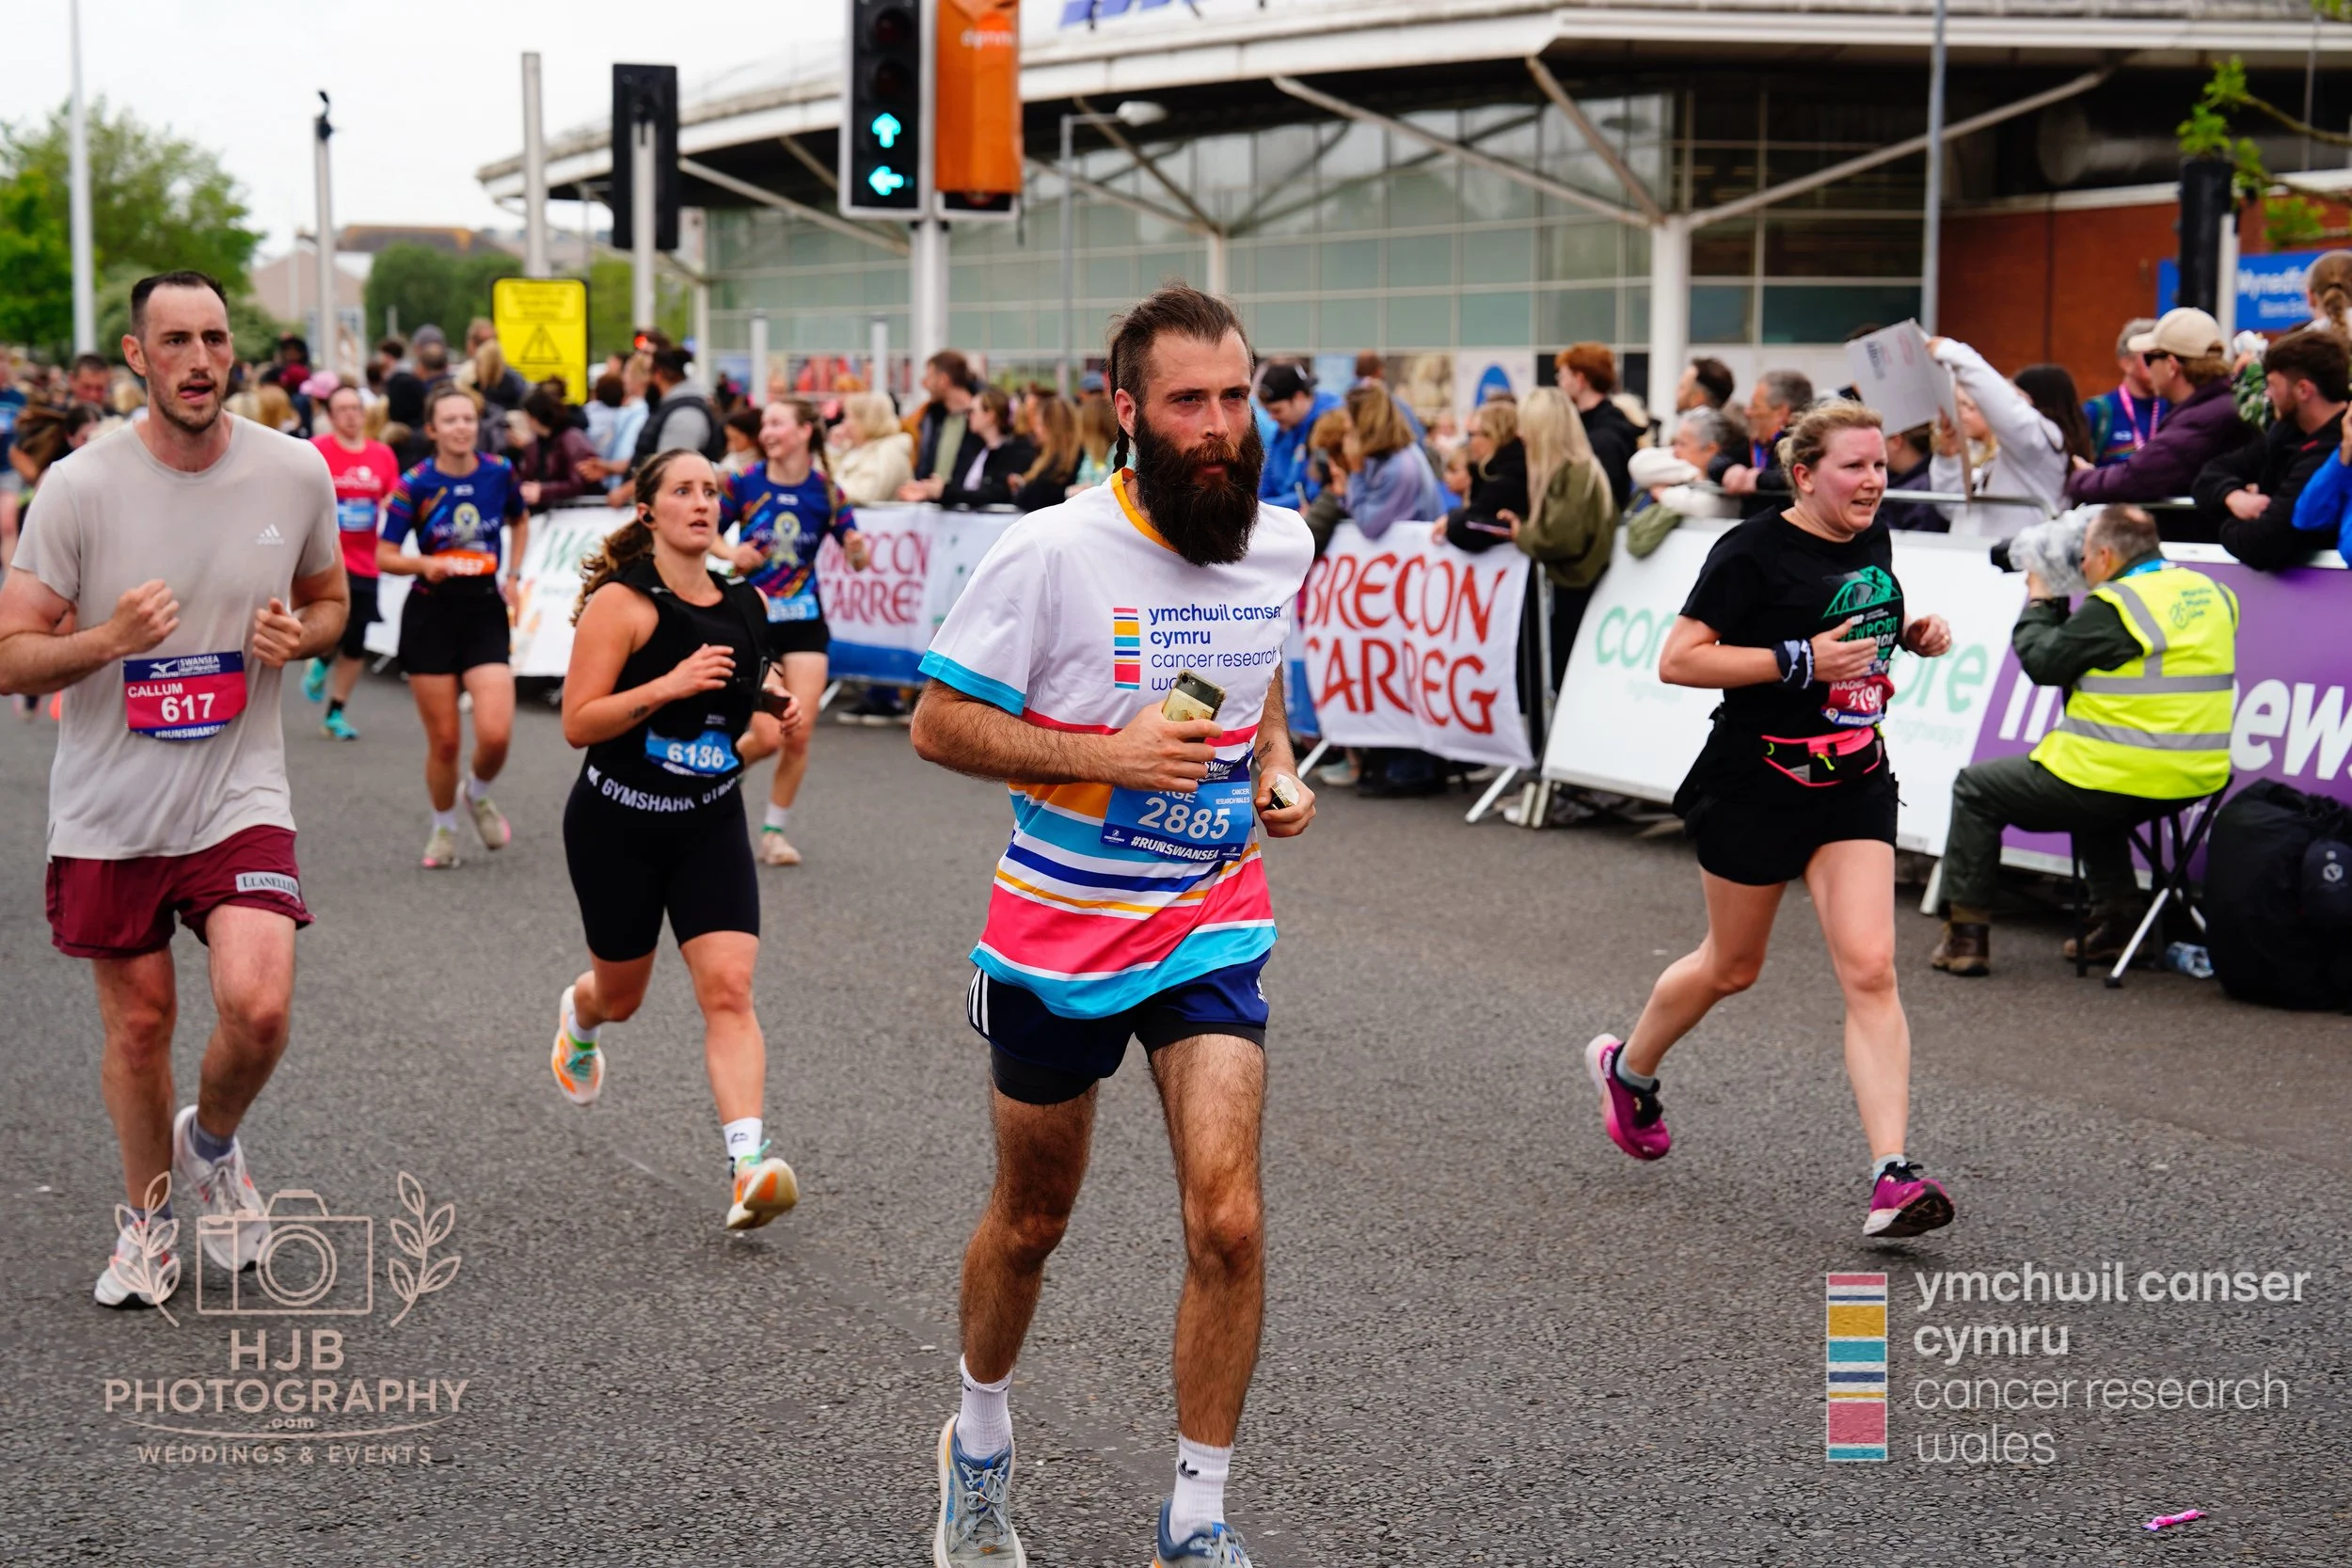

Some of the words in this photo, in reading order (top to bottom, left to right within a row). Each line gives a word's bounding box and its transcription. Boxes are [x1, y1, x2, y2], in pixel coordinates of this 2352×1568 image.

[1305, 551, 1511, 645] BRECON
[1149, 604, 1231, 626] ymchwil
[1151, 630, 1212, 648] cymru
[1595, 605, 1676, 670] cor
[1875, 632, 1897, 647] 10K
[180, 656, 220, 666] SWANSEA
[1152, 654, 1215, 668] cancer
[1216, 646, 1278, 667] research
[128, 683, 183, 698] CALLUM
[1889, 644, 1989, 714] ore
[161, 692, 215, 722] 617
[2230, 678, 2352, 781] ew
[667, 742, 725, 768] 6186
[601, 778, 695, 813] GYMSHARK
[1136, 797, 1232, 841] 2885
[1130, 835, 1220, 861] #RUNSWANSEA
